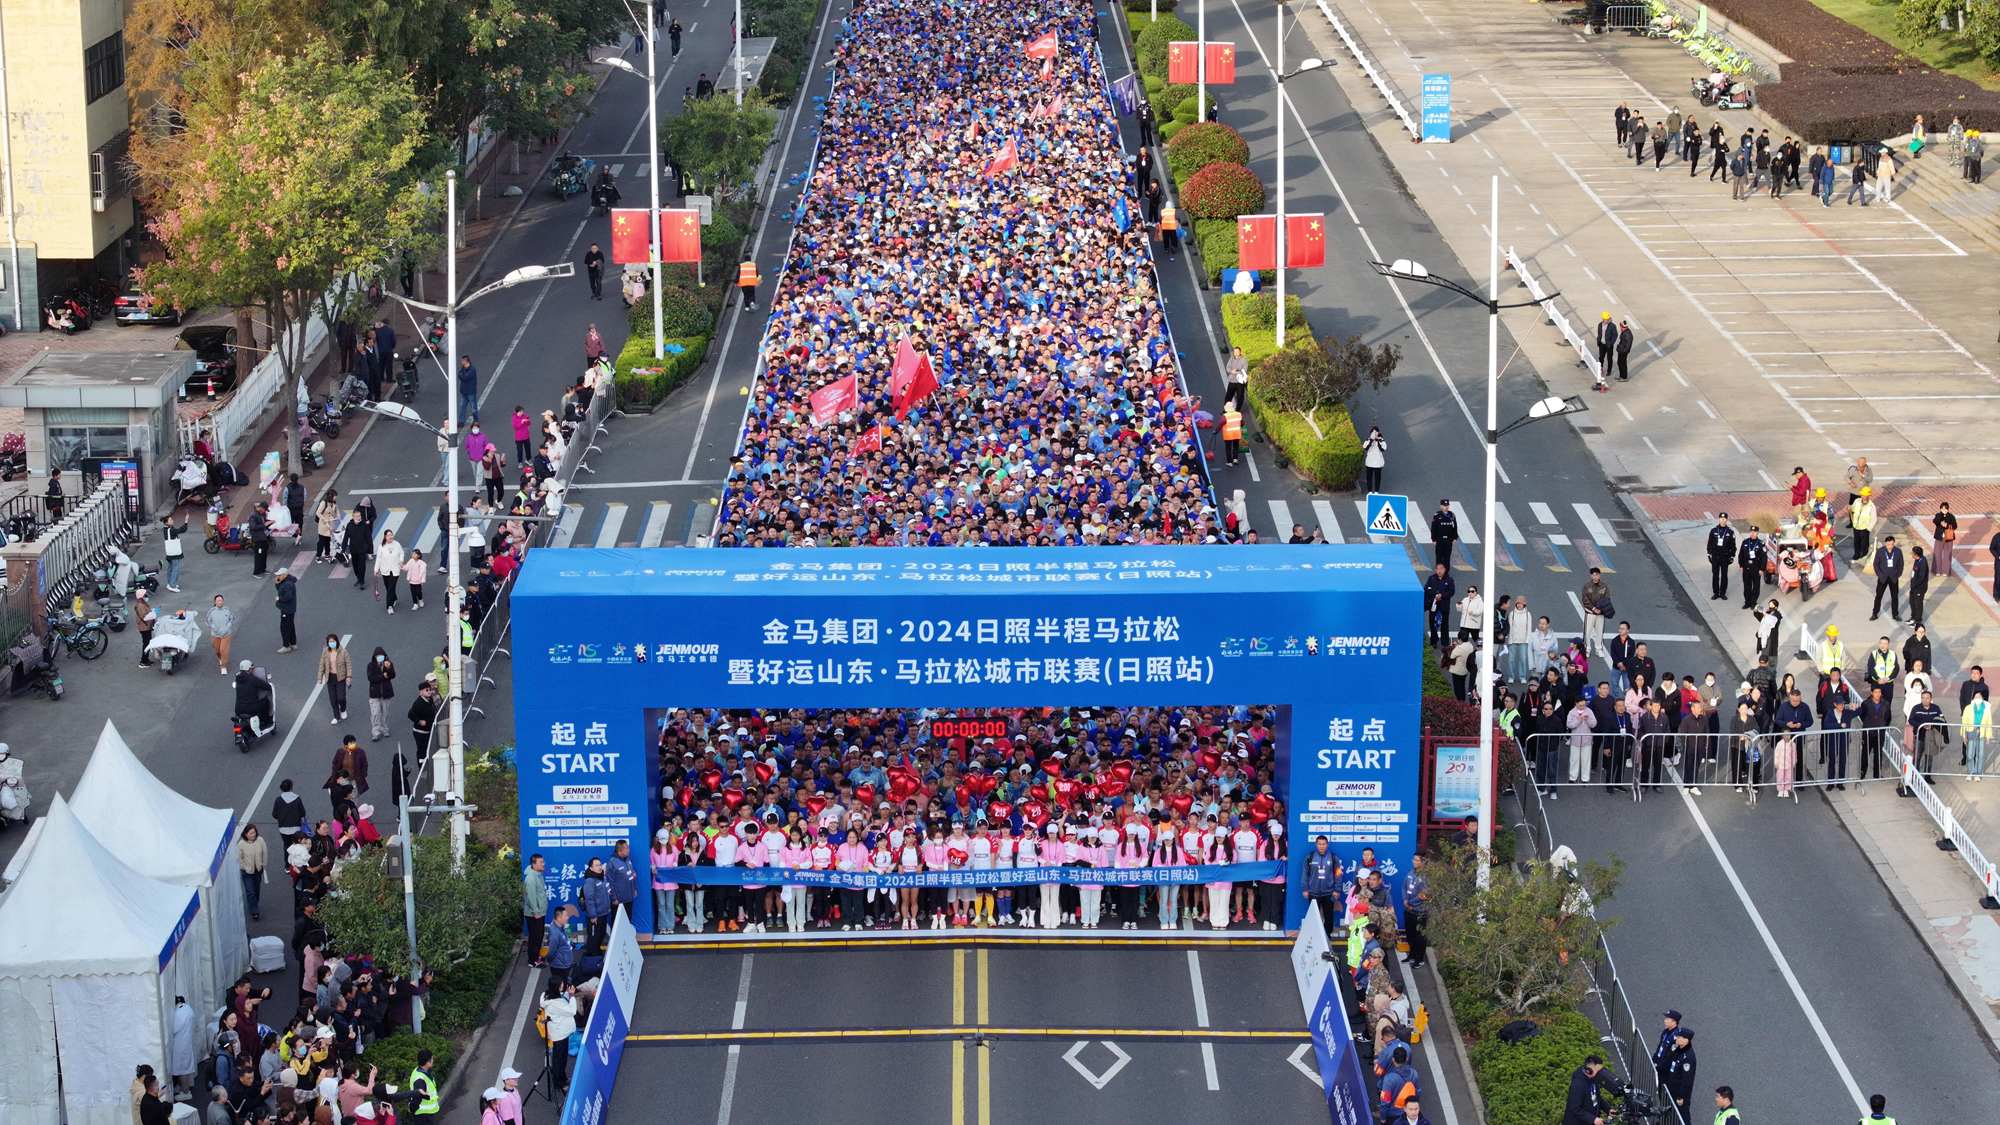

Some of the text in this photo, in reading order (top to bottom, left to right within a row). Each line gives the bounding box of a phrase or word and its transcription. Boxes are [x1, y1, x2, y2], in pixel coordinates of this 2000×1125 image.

[770, 560, 1177, 571] 金马集团·2024日照半程马拉松
[762, 616, 1180, 645] 金马集团·2024日照半程马拉松
[656, 644, 719, 655] JENMOUR
[1327, 636, 1391, 648] JENMOUR
[657, 655, 718, 663] 金马工业集团
[727, 656, 1214, 685] 暨好运山东·马拉松城市联赛(日照站)
[551, 722, 608, 746] 起点
[933, 721, 1006, 738] 00:00:00
[1329, 717, 1386, 742] 起点
[541, 752, 620, 773] START
[1317, 749, 1396, 769] START
[562, 787, 602, 795] JENMOUR
[1335, 783, 1376, 791] JENMOUR
